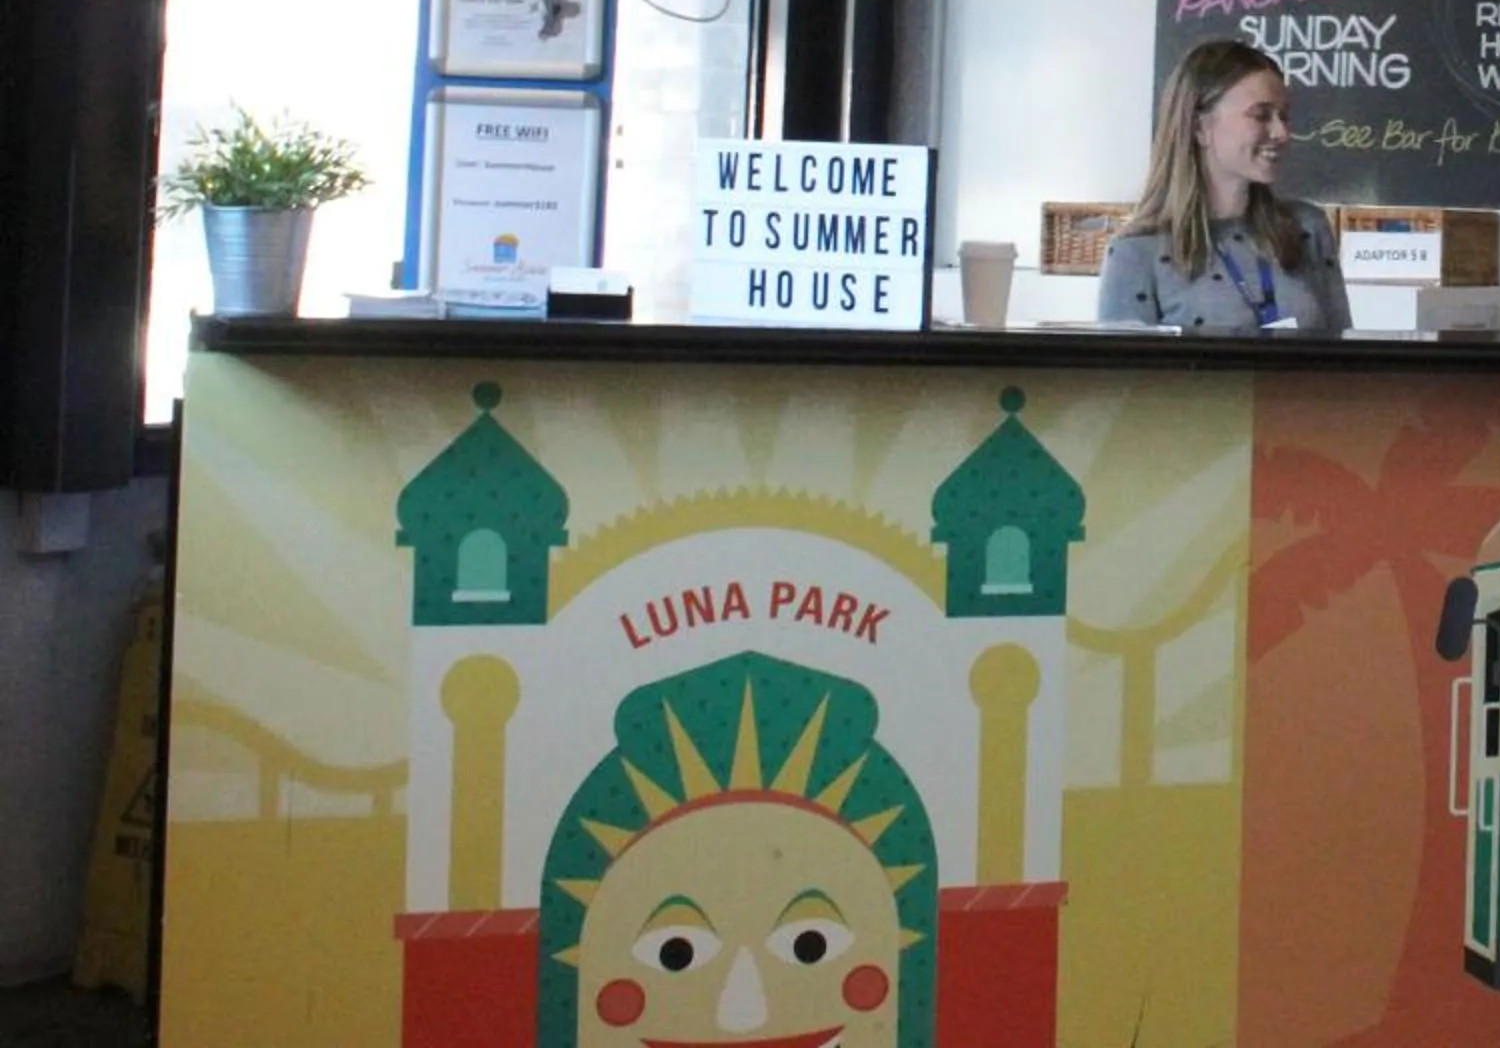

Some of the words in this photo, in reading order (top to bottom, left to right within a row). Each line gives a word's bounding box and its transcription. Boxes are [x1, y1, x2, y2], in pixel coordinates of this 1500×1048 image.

[1240, 14, 1398, 52] SUNDAY
[476, 123, 511, 139] FREE
[1321, 119, 1376, 149] See
[1381, 118, 1434, 151] Bar
[1432, 117, 1480, 168] for
[717, 151, 899, 197] WELCOME
[703, 208, 746, 248] TO
[764, 211, 920, 257] SUMMER
[747, 268, 891, 314] HOUSE
[619, 581, 752, 650] LUNA
[769, 580, 891, 645] PARK
